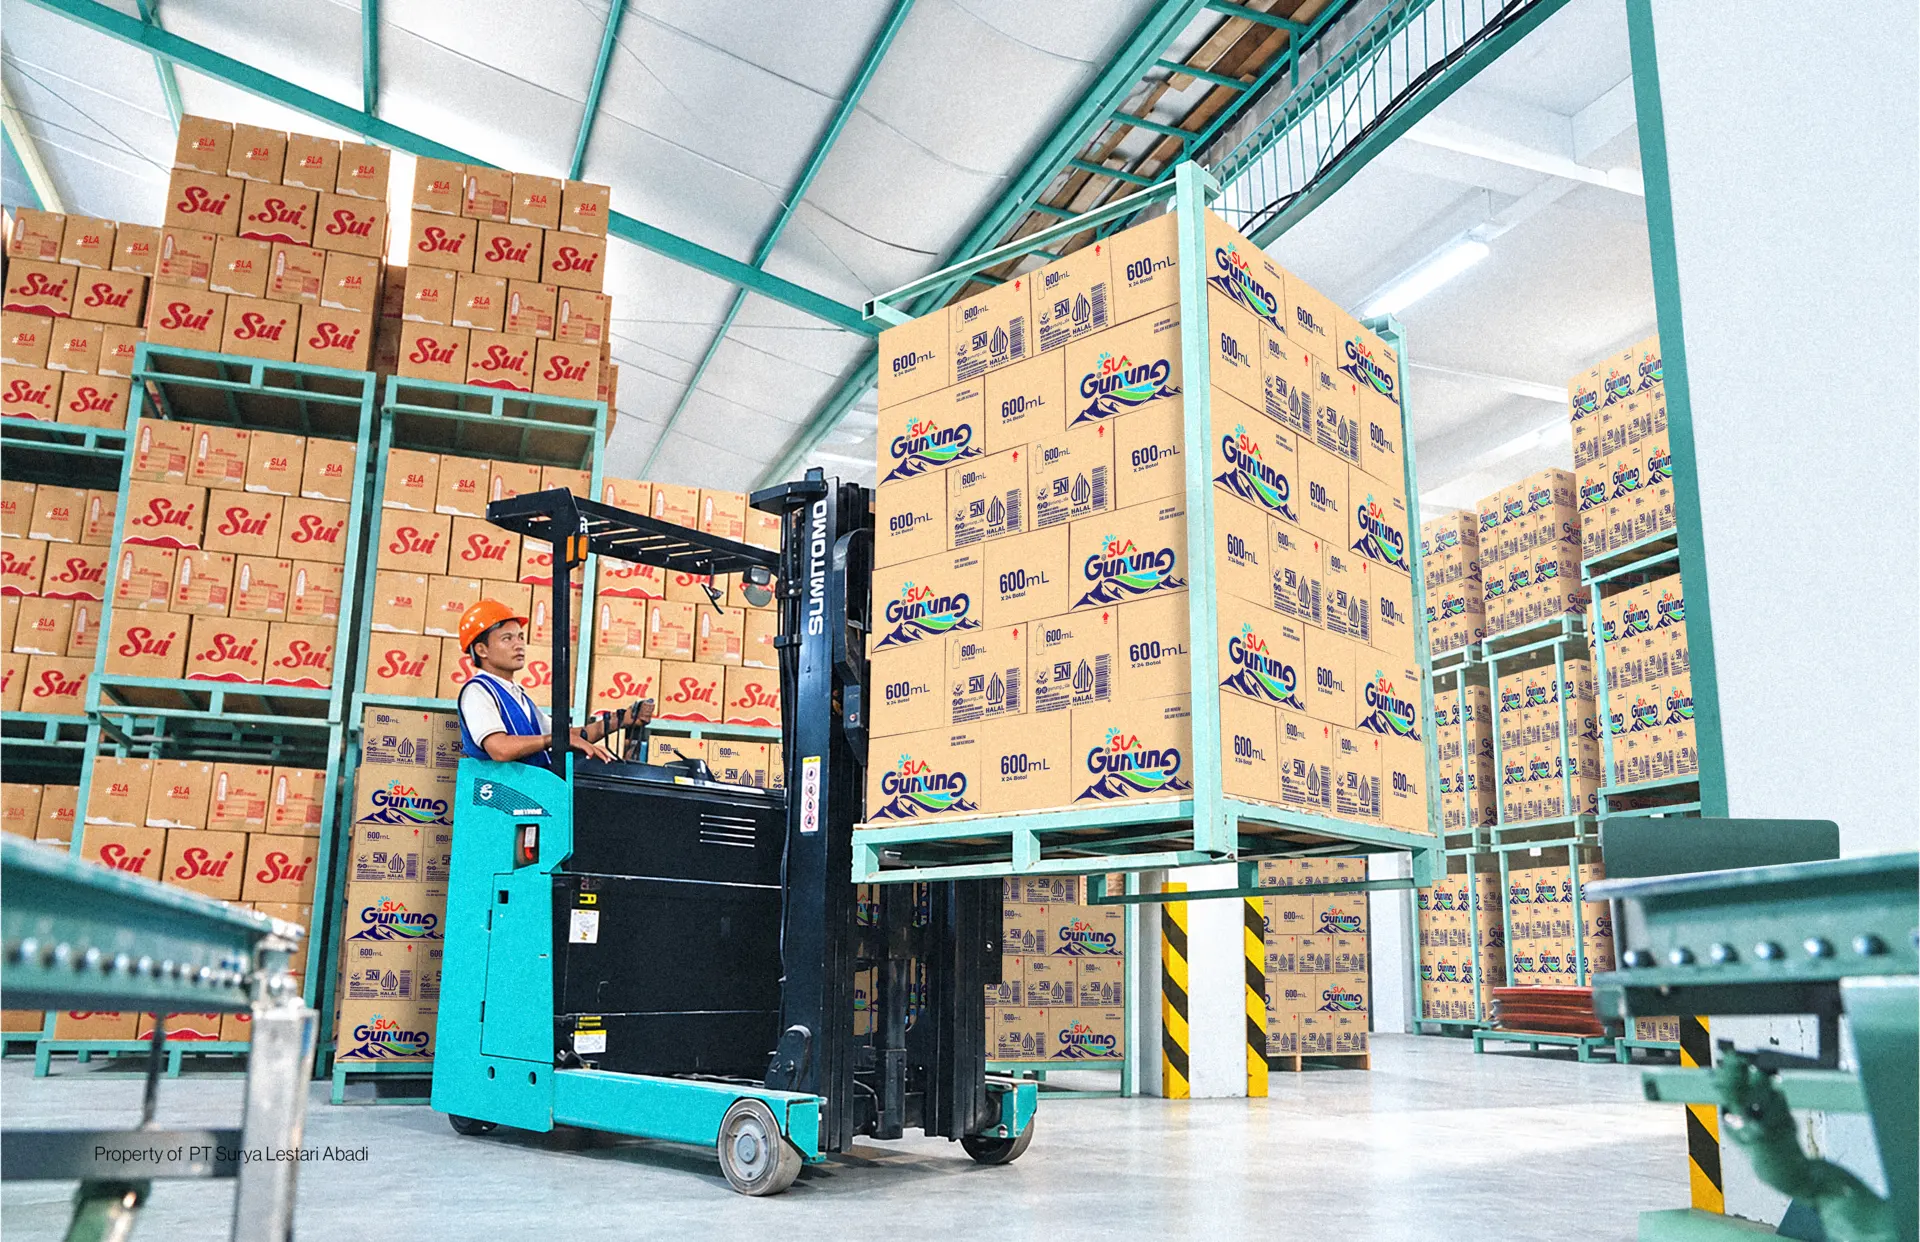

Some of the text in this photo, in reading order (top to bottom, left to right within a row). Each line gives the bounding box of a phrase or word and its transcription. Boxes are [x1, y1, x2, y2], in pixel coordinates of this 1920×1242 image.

[177, 186, 230, 215] Sui
[258, 198, 307, 226] Sui
[326, 210, 375, 237] Sui
[418, 227, 465, 254] Sui
[485, 237, 532, 263] Sui
[552, 247, 599, 273] Sui
[1126, 256, 1176, 282] 600mL
[24, 272, 68, 299] Sui
[1045, 270, 1070, 286] 600mL
[84, 283, 134, 308] Sui
[161, 302, 214, 331] Sui
[964, 304, 989, 320] 600mL
[1297, 306, 1325, 336] 600mL
[234, 312, 286, 341] Sui
[309, 322, 361, 351] Sui
[1072, 322, 1092, 336] HALAL
[409, 337, 459, 364] Sui
[483, 345, 528, 373] Sui
[892, 351, 936, 372] 600mL
[989, 355, 1009, 367] HALAL
[1221, 332, 1250, 367] 600mL
[544, 355, 590, 381] Sui
[3, 379, 50, 404] Sui
[69, 386, 118, 413] Sui
[1001, 394, 1045, 417] 600mL
[1370, 422, 1395, 453] 600mL
[1044, 446, 1070, 462] 600mL
[1131, 445, 1180, 467] 600mL
[962, 471, 986, 485] 600mL
[1310, 481, 1338, 511] 600mL
[142, 498, 194, 526] Sui
[218, 507, 271, 536] Sui
[890, 511, 932, 532] 600mL
[1071, 504, 1091, 516] HALAL
[291, 515, 344, 544] Sui
[389, 526, 440, 554] Sui
[986, 526, 1006, 535] HALAL
[461, 533, 511, 562] Sui
[1227, 533, 1258, 565] 600mL
[809, 500, 827, 635] SUMITOMO
[999, 569, 1049, 593] 600mL
[1381, 597, 1404, 624] 600mL
[119, 627, 176, 657] Sui
[205, 633, 258, 663] Sui
[1045, 629, 1073, 642] 600mL
[282, 640, 331, 669] Sui
[961, 644, 986, 657] 600mL
[1129, 641, 1187, 662] 600mL
[377, 650, 430, 679] Sui
[33, 670, 86, 697] Sui
[609, 672, 652, 700] Sui
[885, 681, 930, 700] 600mL
[1317, 667, 1345, 691] 600mL
[985, 704, 1004, 714] HALAL
[1072, 693, 1093, 704] HALAL
[377, 713, 399, 724] 600mL
[1234, 735, 1265, 761] 600mL
[1001, 753, 1050, 775] 600mL
[1392, 771, 1418, 795] 600mL
[367, 831, 390, 840] 600mL
[176, 847, 234, 880] Sui
[1284, 912, 1304, 920] 600mL
[360, 948, 383, 957] 600mL
[1285, 990, 1307, 998] 600mL
